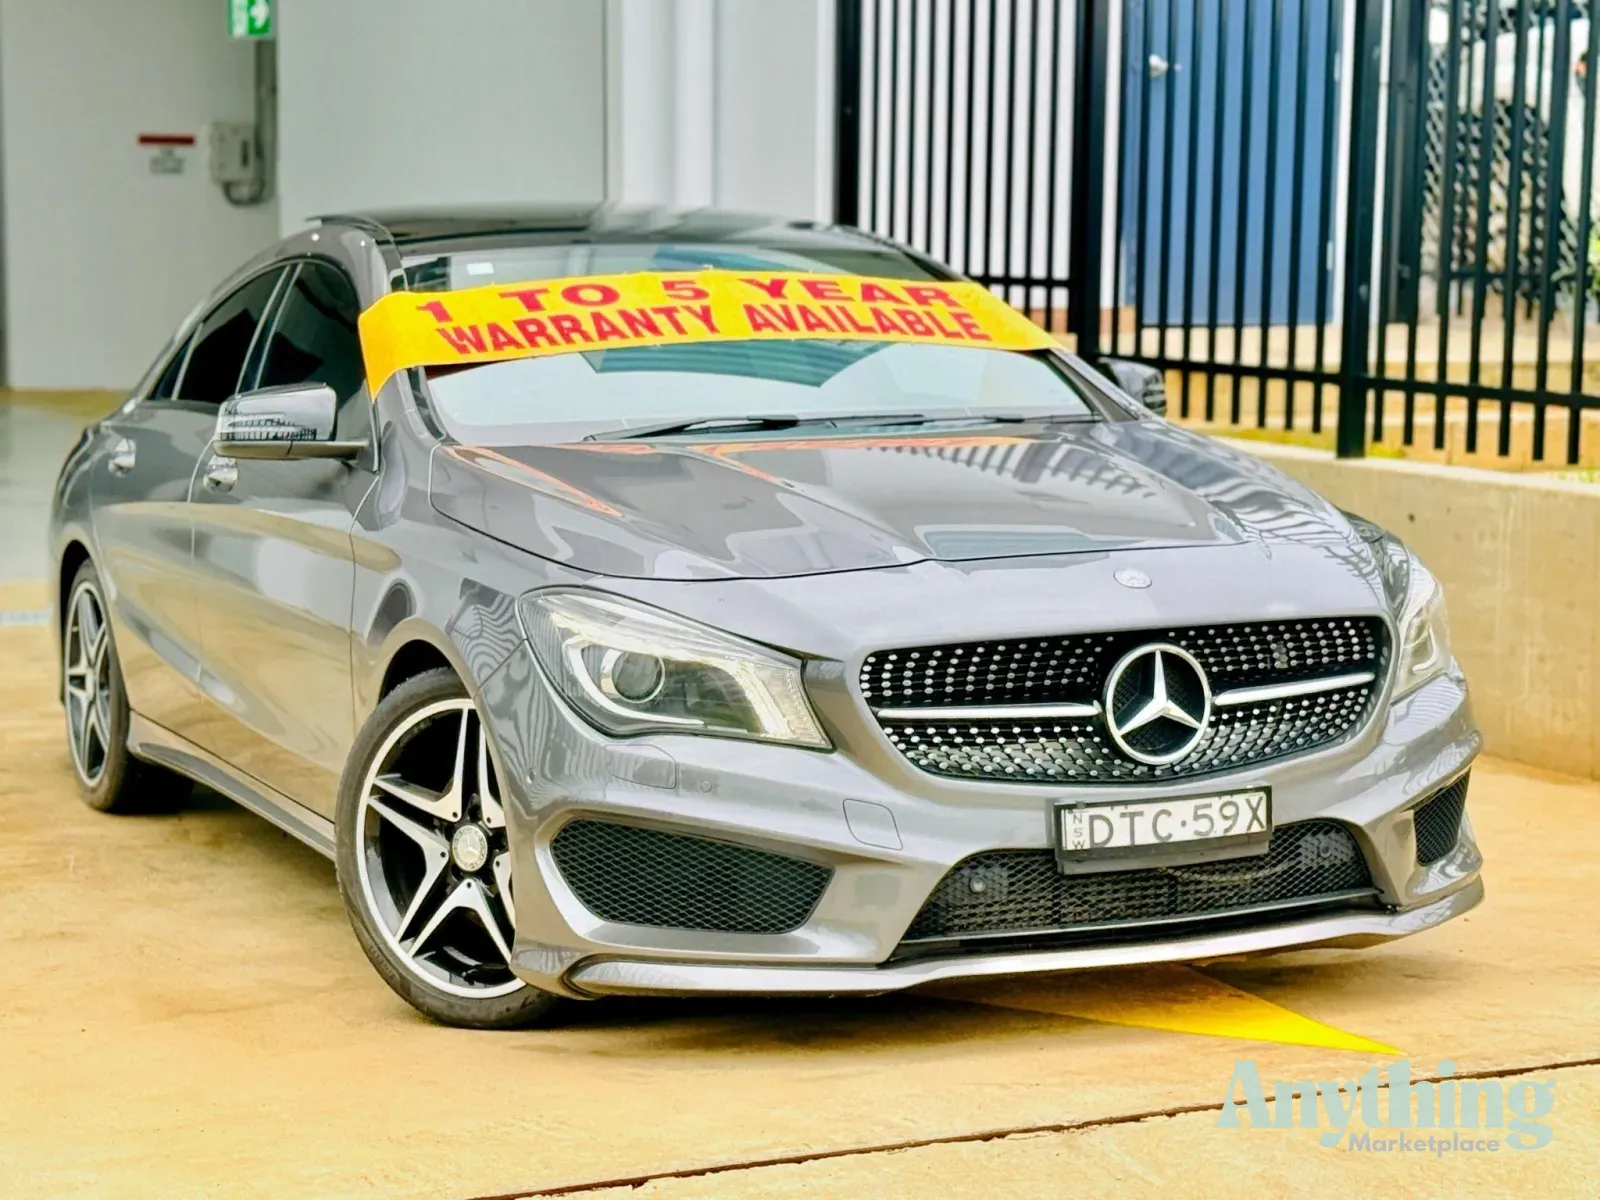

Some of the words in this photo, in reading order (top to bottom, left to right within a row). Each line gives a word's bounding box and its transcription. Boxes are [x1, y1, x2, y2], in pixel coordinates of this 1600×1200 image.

[415, 300, 454, 322] 1
[499, 283, 621, 313] TO
[661, 280, 710, 300] 5
[737, 278, 962, 307] YEAR
[436, 304, 721, 355] WARRANTY
[741, 304, 993, 341] AVAILABLE
